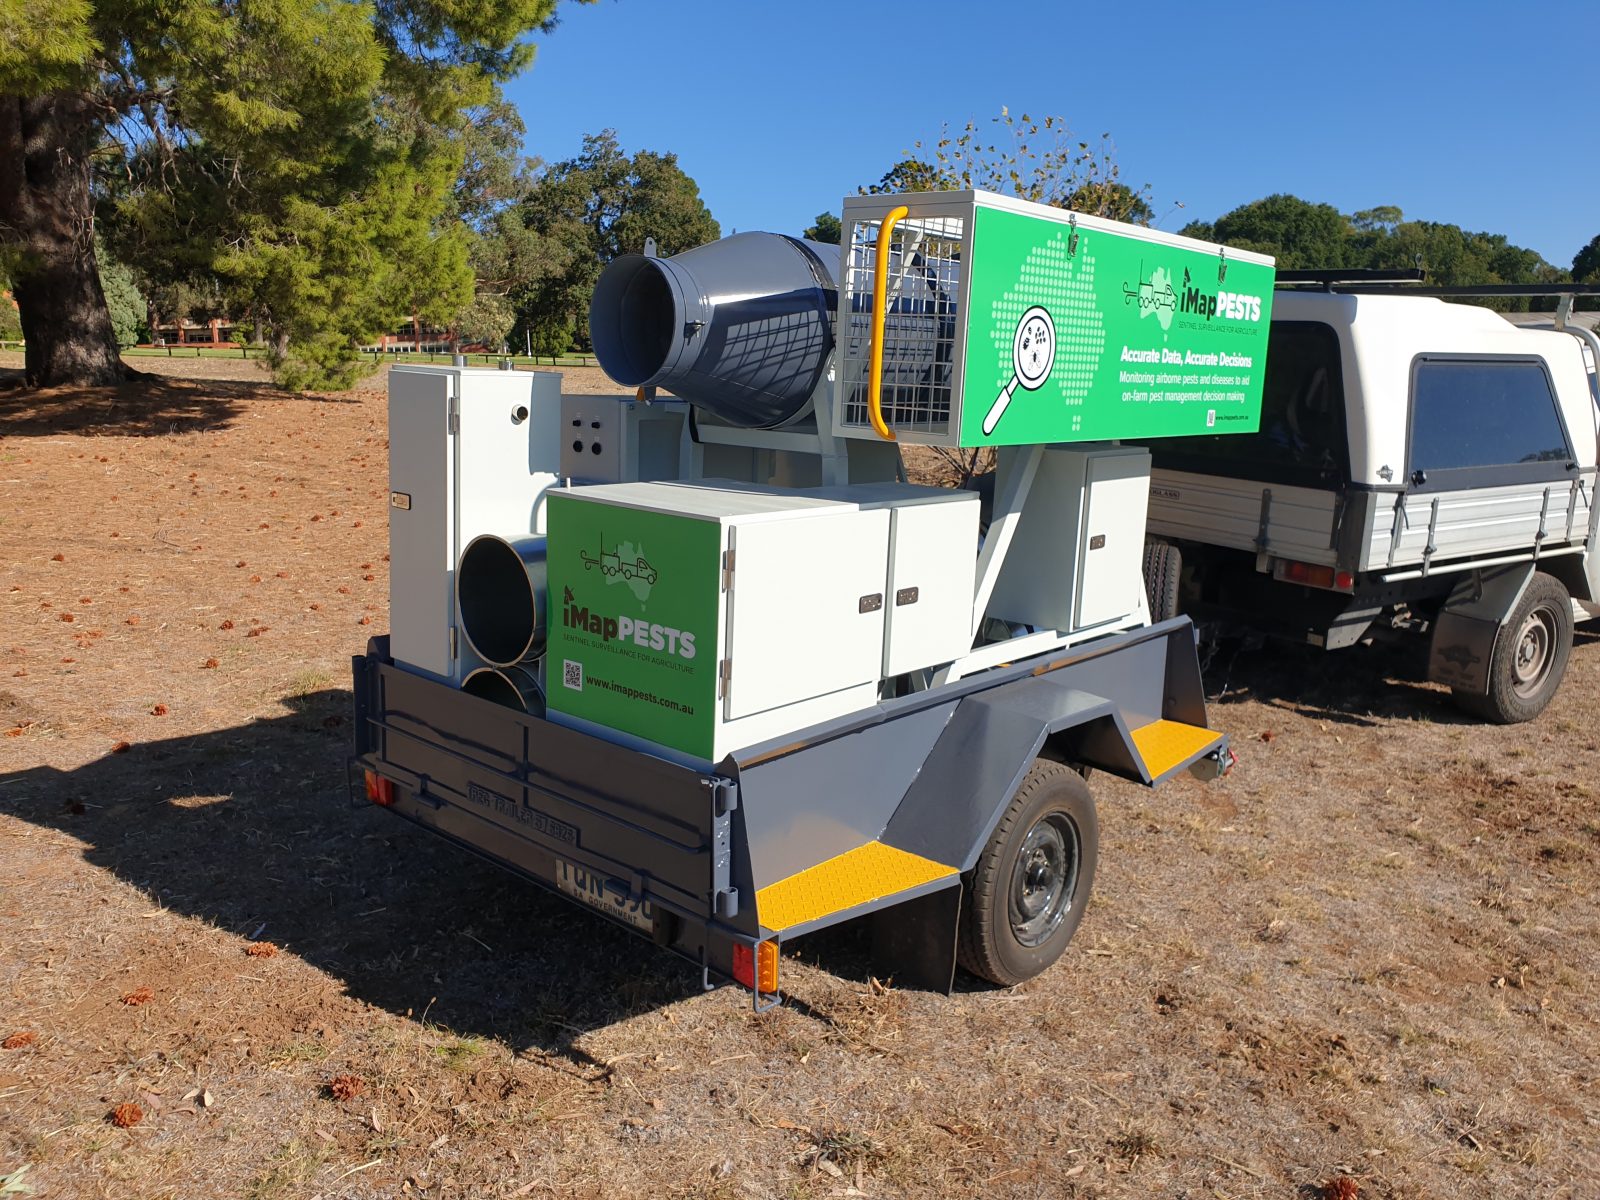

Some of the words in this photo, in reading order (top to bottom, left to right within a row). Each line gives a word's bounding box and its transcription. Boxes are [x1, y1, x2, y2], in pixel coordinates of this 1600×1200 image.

[1180, 266, 1261, 322] iMapPESTS
[1120, 345, 1160, 364] Accurate
[1161, 348, 1183, 367] Data,
[1184, 349, 1218, 366] Accurate
[1219, 351, 1252, 368] Decisions
[1119, 371, 1155, 387] Monitoring
[1156, 372, 1181, 384] airborne
[1182, 374, 1199, 387] pests
[1200, 374, 1211, 385] and
[1211, 374, 1234, 385] diseases
[1235, 375, 1241, 386] to
[1242, 374, 1250, 386] aid
[1122, 389, 1148, 402] on-farm
[1149, 390, 1164, 404] pest
[1165, 391, 1202, 404] management
[1203, 390, 1226, 402] decision
[1226, 390, 1245, 404] making
[563, 585, 696, 659] iMapPESTS
[563, 633, 590, 648] SENTINEL
[591, 641, 637, 659] SURVEILLANCE
[637, 652, 651, 663] FOR
[651, 656, 694, 675] AGRICULTURE
[586, 675, 694, 716] www.imappests.com.au
[574, 888, 584, 899] SA
[588, 896, 638, 925] GOVERNMENT
